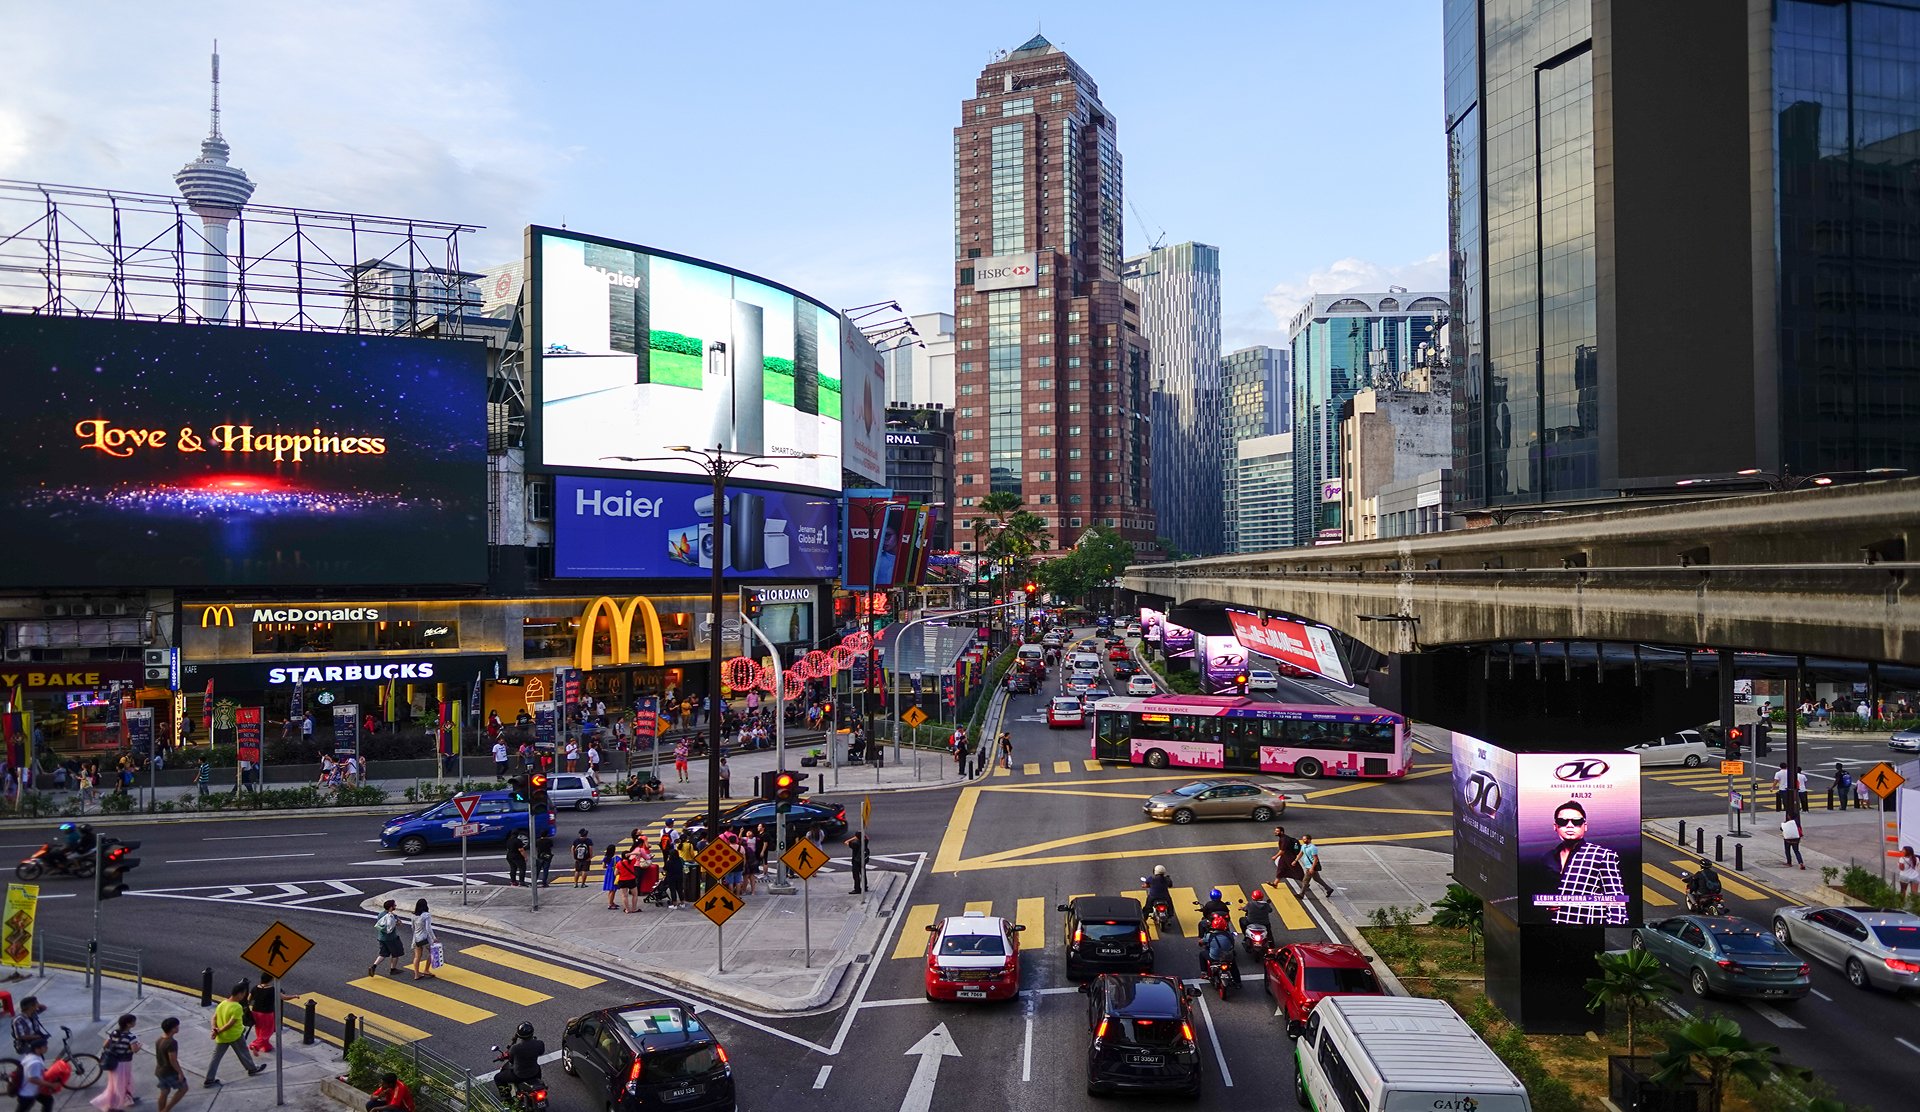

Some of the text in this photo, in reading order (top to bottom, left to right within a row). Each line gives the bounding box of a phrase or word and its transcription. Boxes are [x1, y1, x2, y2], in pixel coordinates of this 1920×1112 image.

[978, 267, 1011, 279] HSBC
[75, 420, 386, 463] Love & Happiness
[576, 489, 663, 518] Haier
[798, 525, 828, 545] Global #1
[758, 589, 809, 602] GIORDANO
[252, 608, 379, 622] McDonald's
[184, 665, 197, 673] KAFE
[269, 662, 434, 684] STARBUCKS
[28, 672, 99, 686] BAKE
